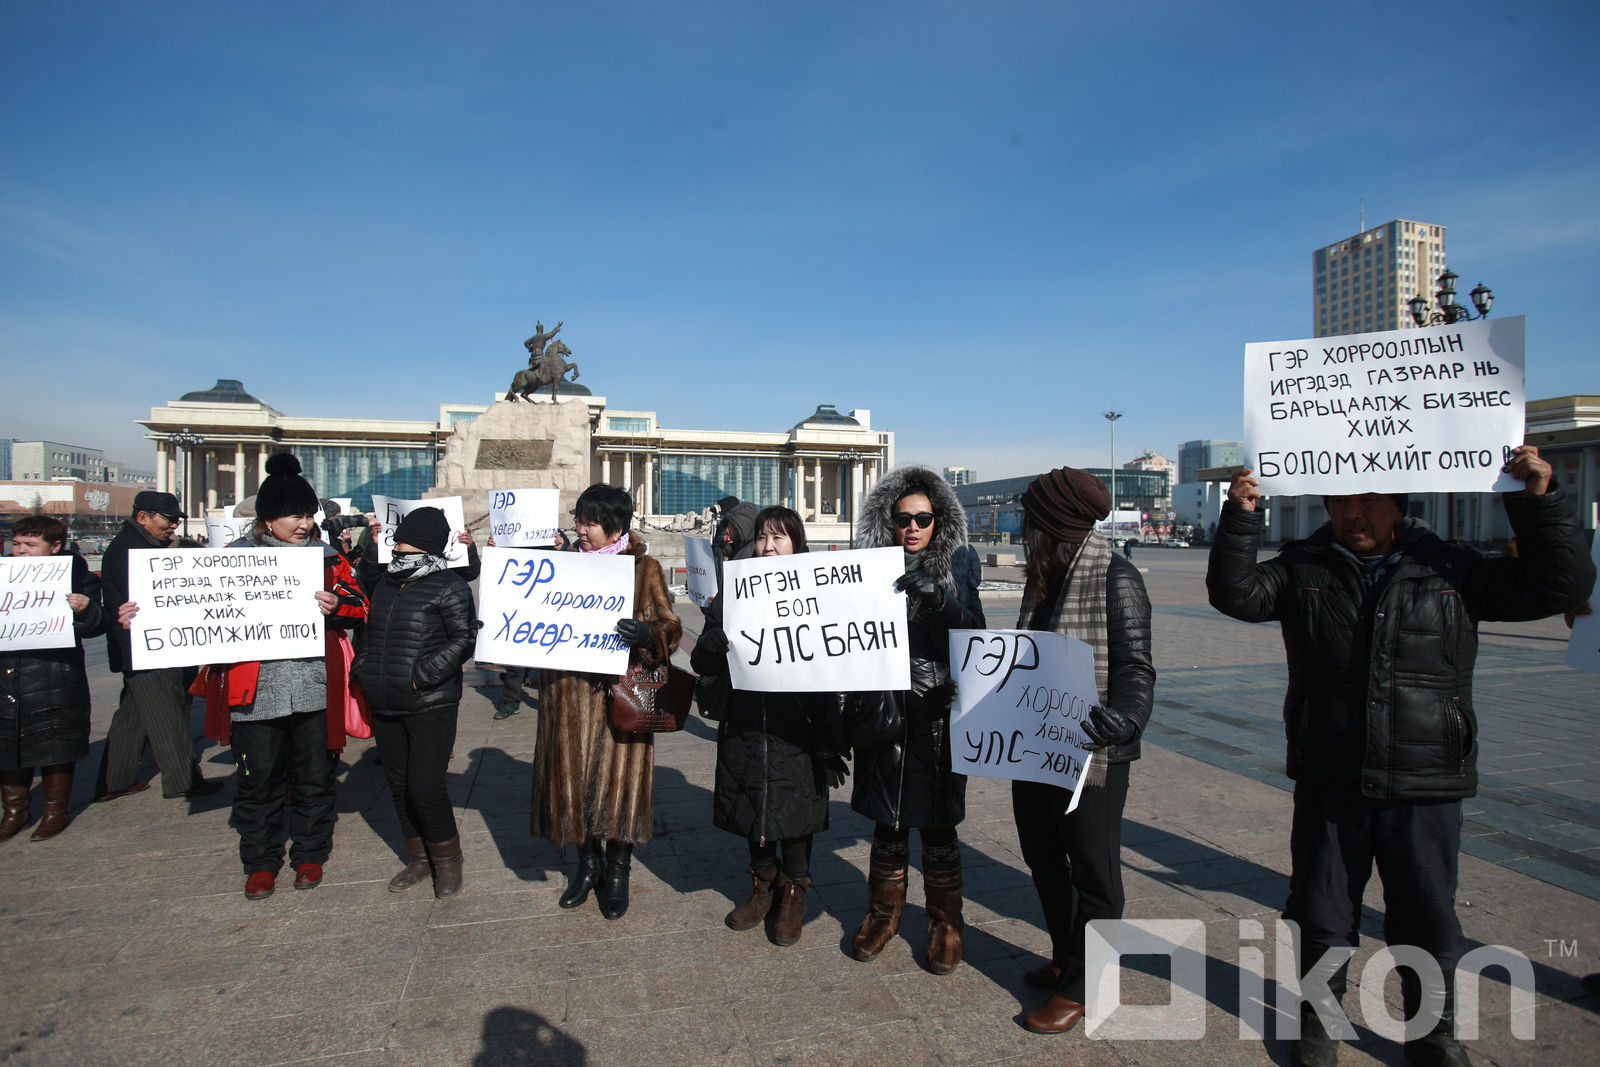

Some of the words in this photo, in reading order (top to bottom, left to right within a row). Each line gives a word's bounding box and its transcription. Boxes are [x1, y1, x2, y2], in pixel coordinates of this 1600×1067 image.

[1269, 349, 1308, 372] ГЭР
[1322, 333, 1464, 365] ХОРРООЛЛЫН
[1271, 373, 1354, 397] ИРГЭДЭД
[1367, 362, 1466, 385] ГАЗРААР
[1473, 360, 1500, 376] НЬ
[1270, 394, 1412, 422] БАРЬЦААЛЖ
[1423, 389, 1512, 410] БИЗНЕС
[1347, 414, 1413, 438] ХИЙХ
[1258, 444, 1431, 478] БОЛОМЖИЙГ
[493, 491, 516, 511] ГЭР
[150, 556, 183, 572] ГЭР
[192, 555, 277, 569] ХОРООЛЛЫН
[498, 558, 556, 599] ГЭР
[153, 577, 212, 590] ИРГЭДЭД
[220, 575, 277, 588] ГАЗРААР
[284, 576, 300, 586] НЬ
[734, 570, 800, 600] ИРГЭН
[813, 564, 863, 586] БАЯН
[154, 592, 236, 608] БАРЬЦААЛЖ
[245, 590, 293, 601] БИЗНЕС
[203, 603, 246, 620] ХИЙХ
[776, 597, 819, 618] БОЛ
[144, 622, 273, 651] БОЛОМЖИЙГ
[280, 622, 318, 640] ОЛГО!
[739, 624, 814, 667] УЛС
[821, 621, 897, 657] БАЯН
[961, 634, 1039, 694] ГЭР
